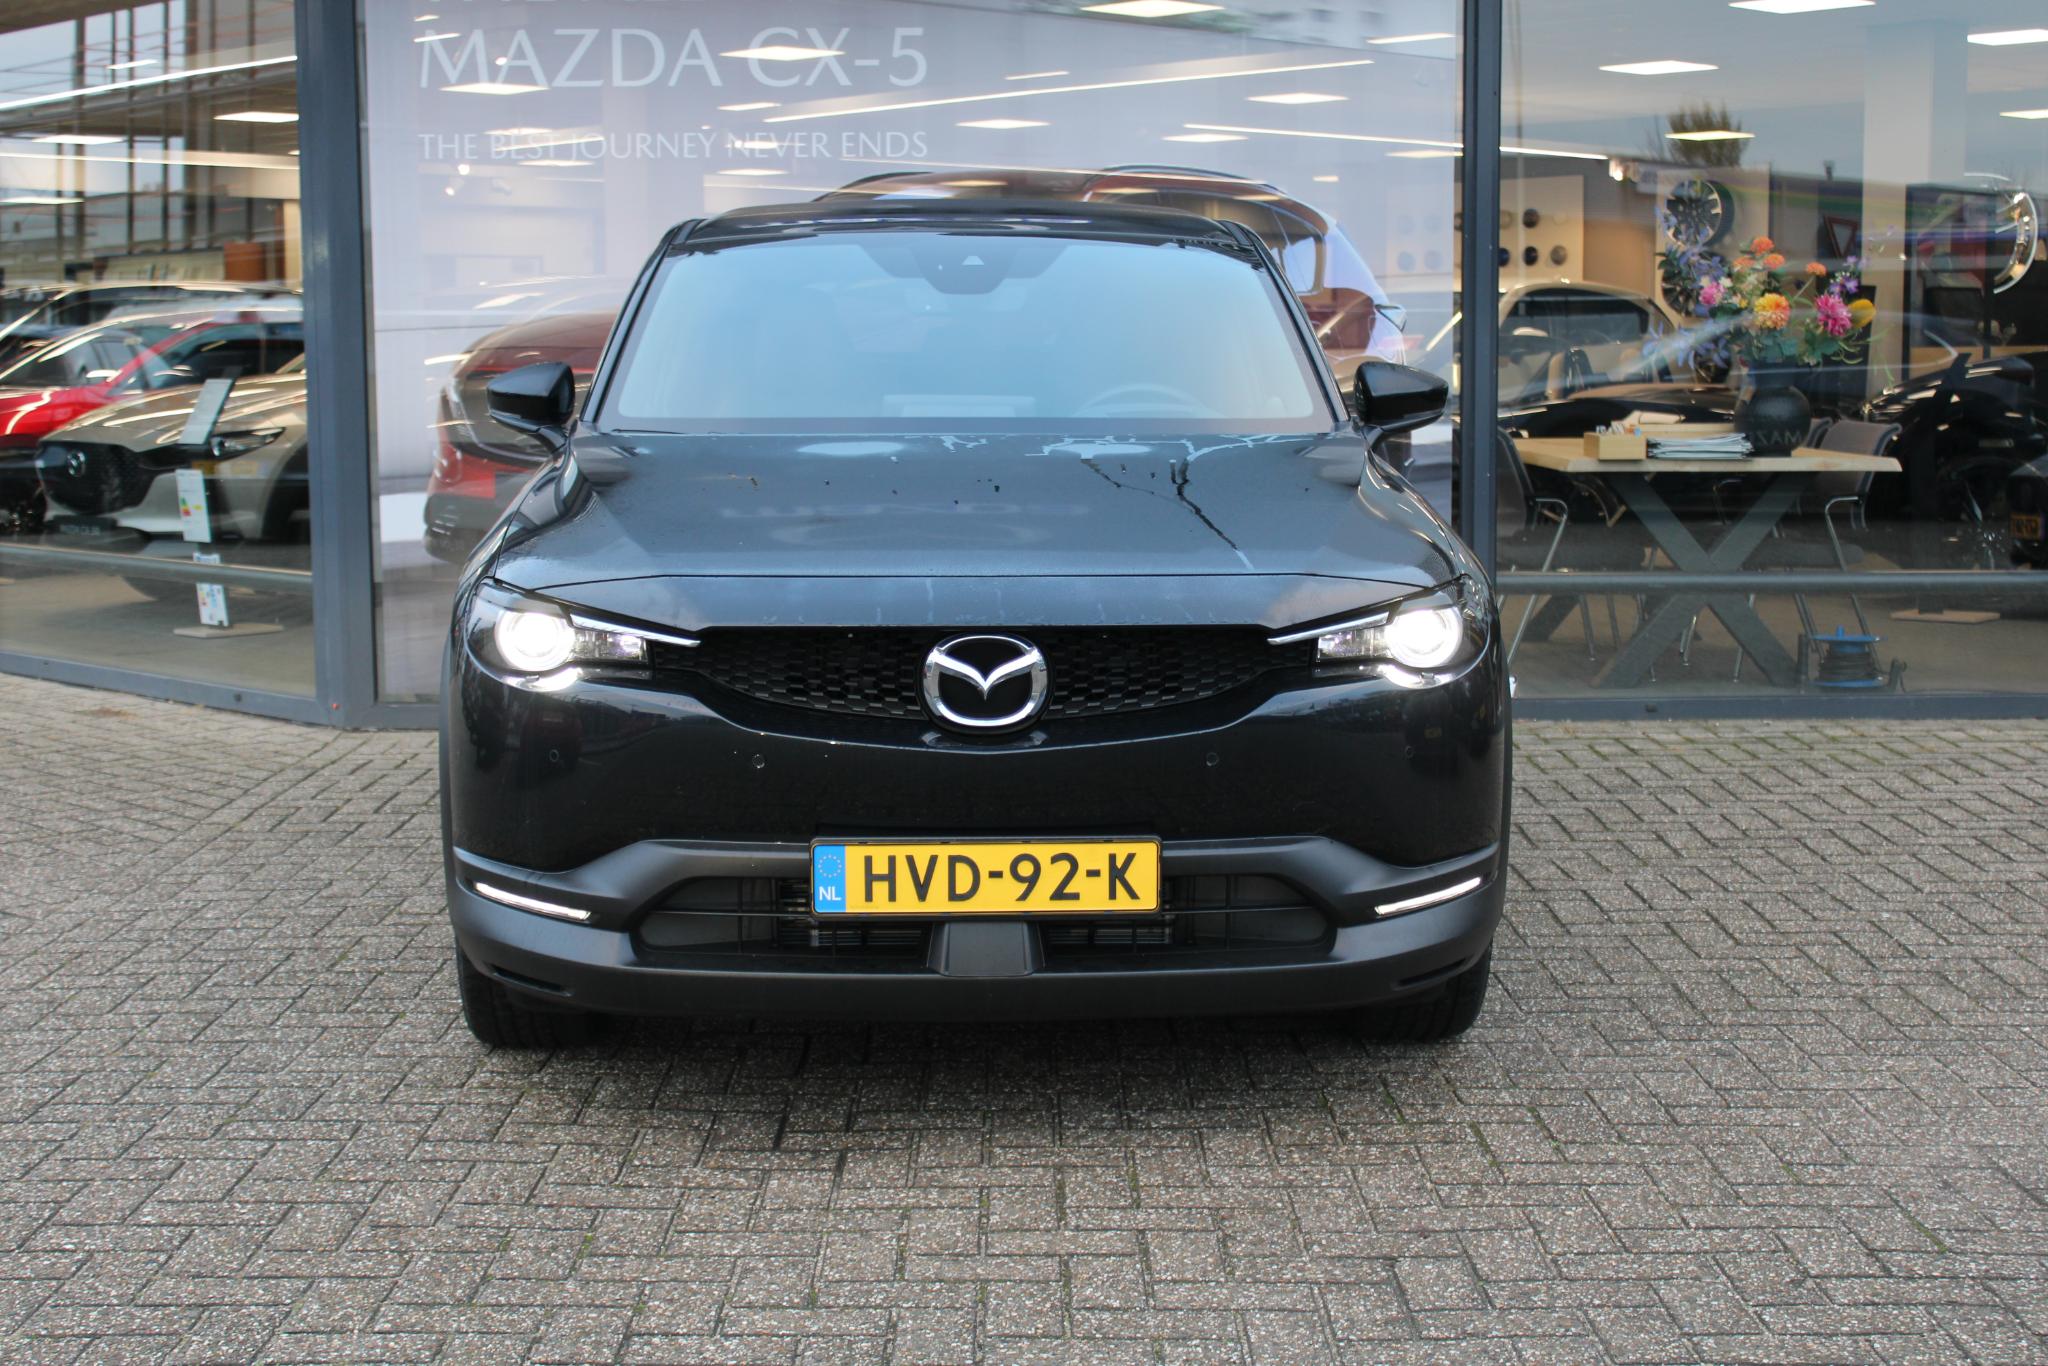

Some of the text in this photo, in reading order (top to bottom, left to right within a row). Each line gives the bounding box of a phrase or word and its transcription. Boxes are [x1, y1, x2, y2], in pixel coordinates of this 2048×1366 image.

[419, 26, 928, 89] MAZDA CX-5
[418, 131, 928, 161] THE BEST JOURNEY NEVER ENDS
[818, 886, 842, 902] NL
[863, 851, 1141, 903] HVD-92-K
